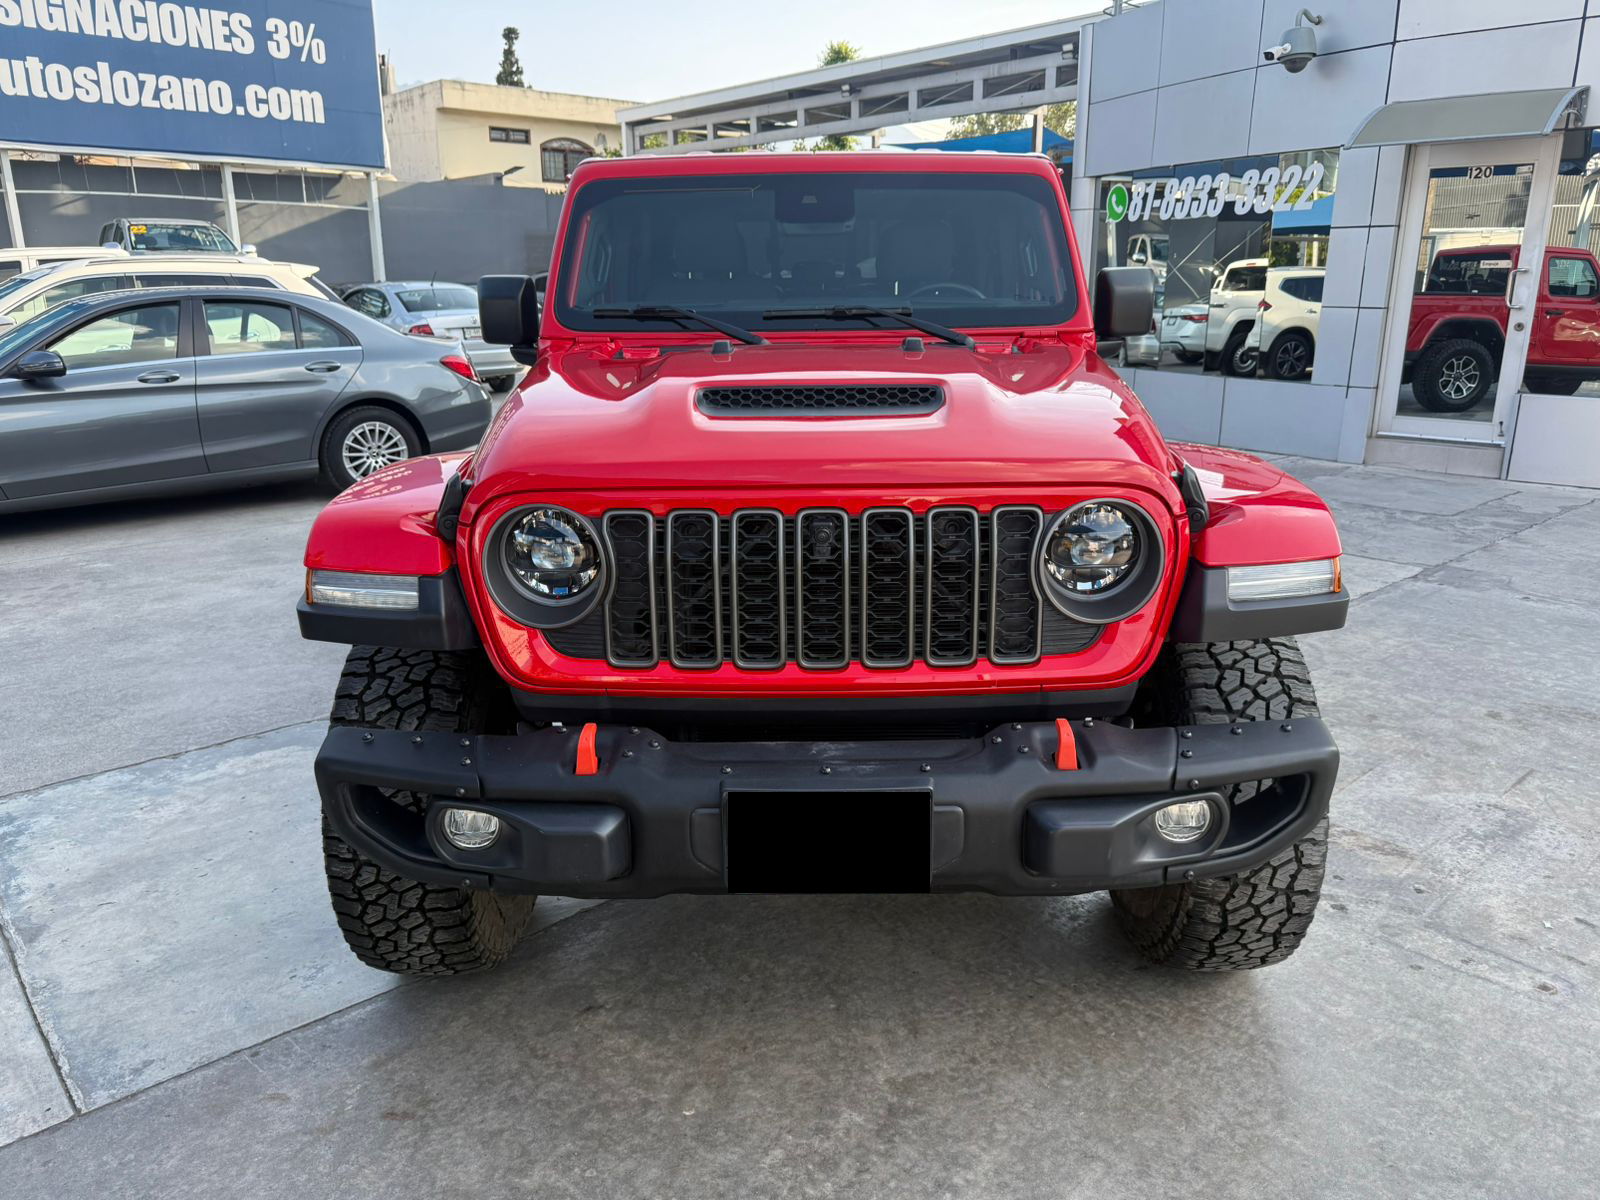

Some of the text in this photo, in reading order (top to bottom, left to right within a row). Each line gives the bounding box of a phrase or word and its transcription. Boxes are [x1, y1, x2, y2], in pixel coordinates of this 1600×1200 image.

[265, 17, 326, 64] 3%
[0, 56, 325, 124] utoslozano.com
[1127, 162, 1325, 222] 81-8333-3322
[1468, 166, 1493, 179] 120
